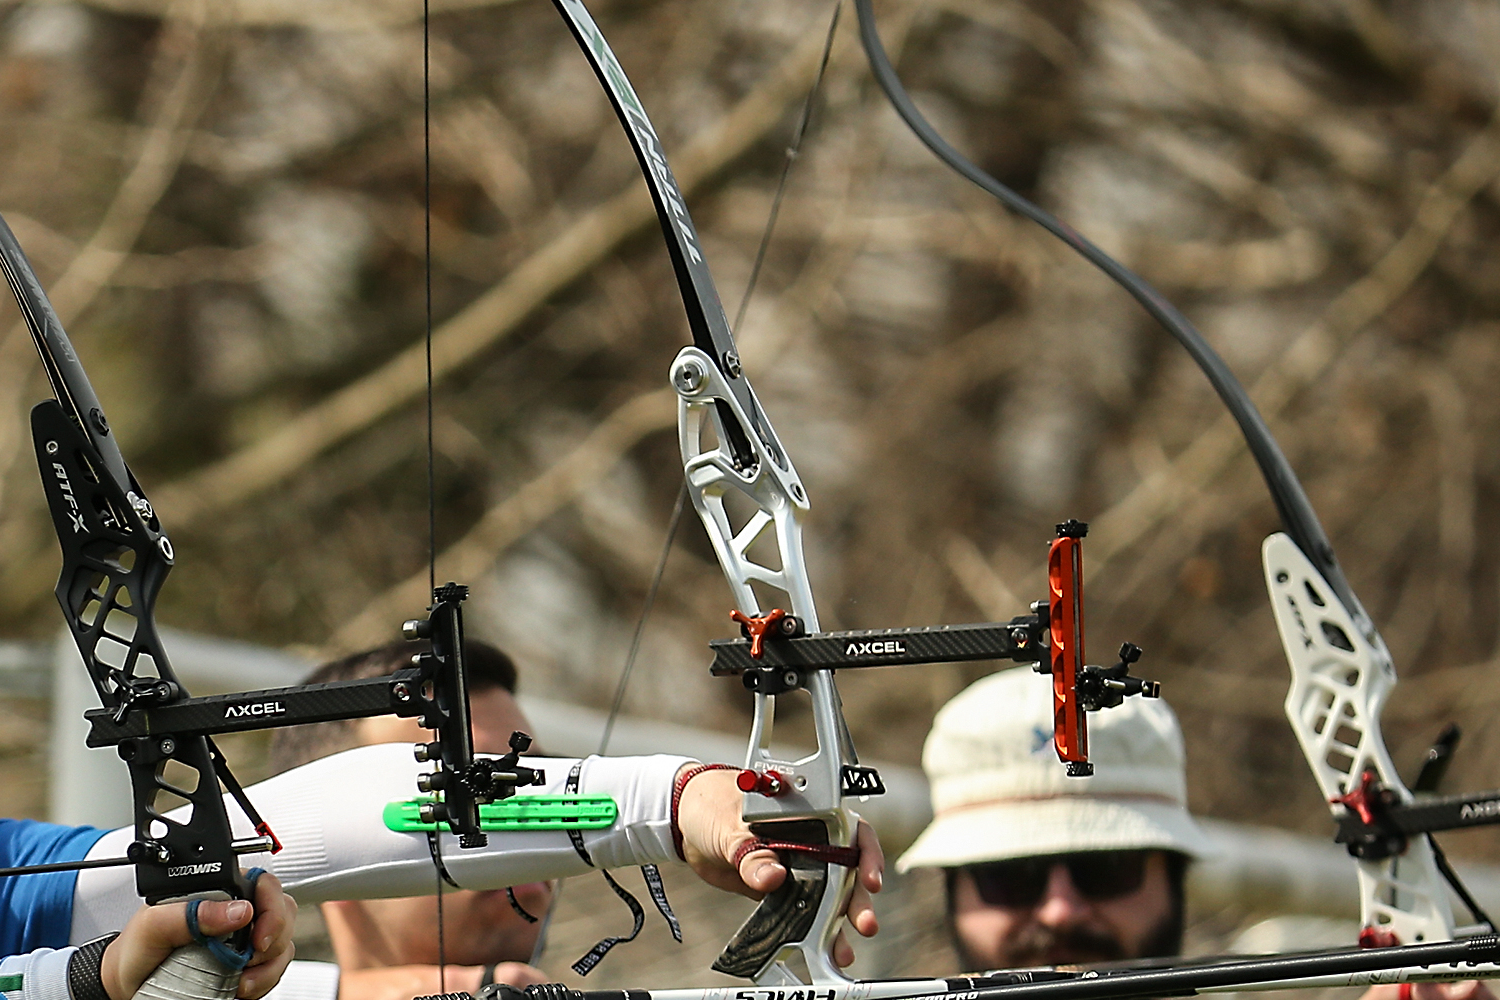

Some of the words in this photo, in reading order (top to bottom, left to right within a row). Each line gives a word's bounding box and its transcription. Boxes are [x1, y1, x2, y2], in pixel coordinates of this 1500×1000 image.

[52, 462, 91, 534] ATF-X
[845, 641, 906, 656] AXCEL
[224, 701, 286, 718] AXCEL
[754, 761, 795, 775] FIVICS
[1460, 801, 1500, 820] AXC
[167, 862, 222, 877] WIAWIS
